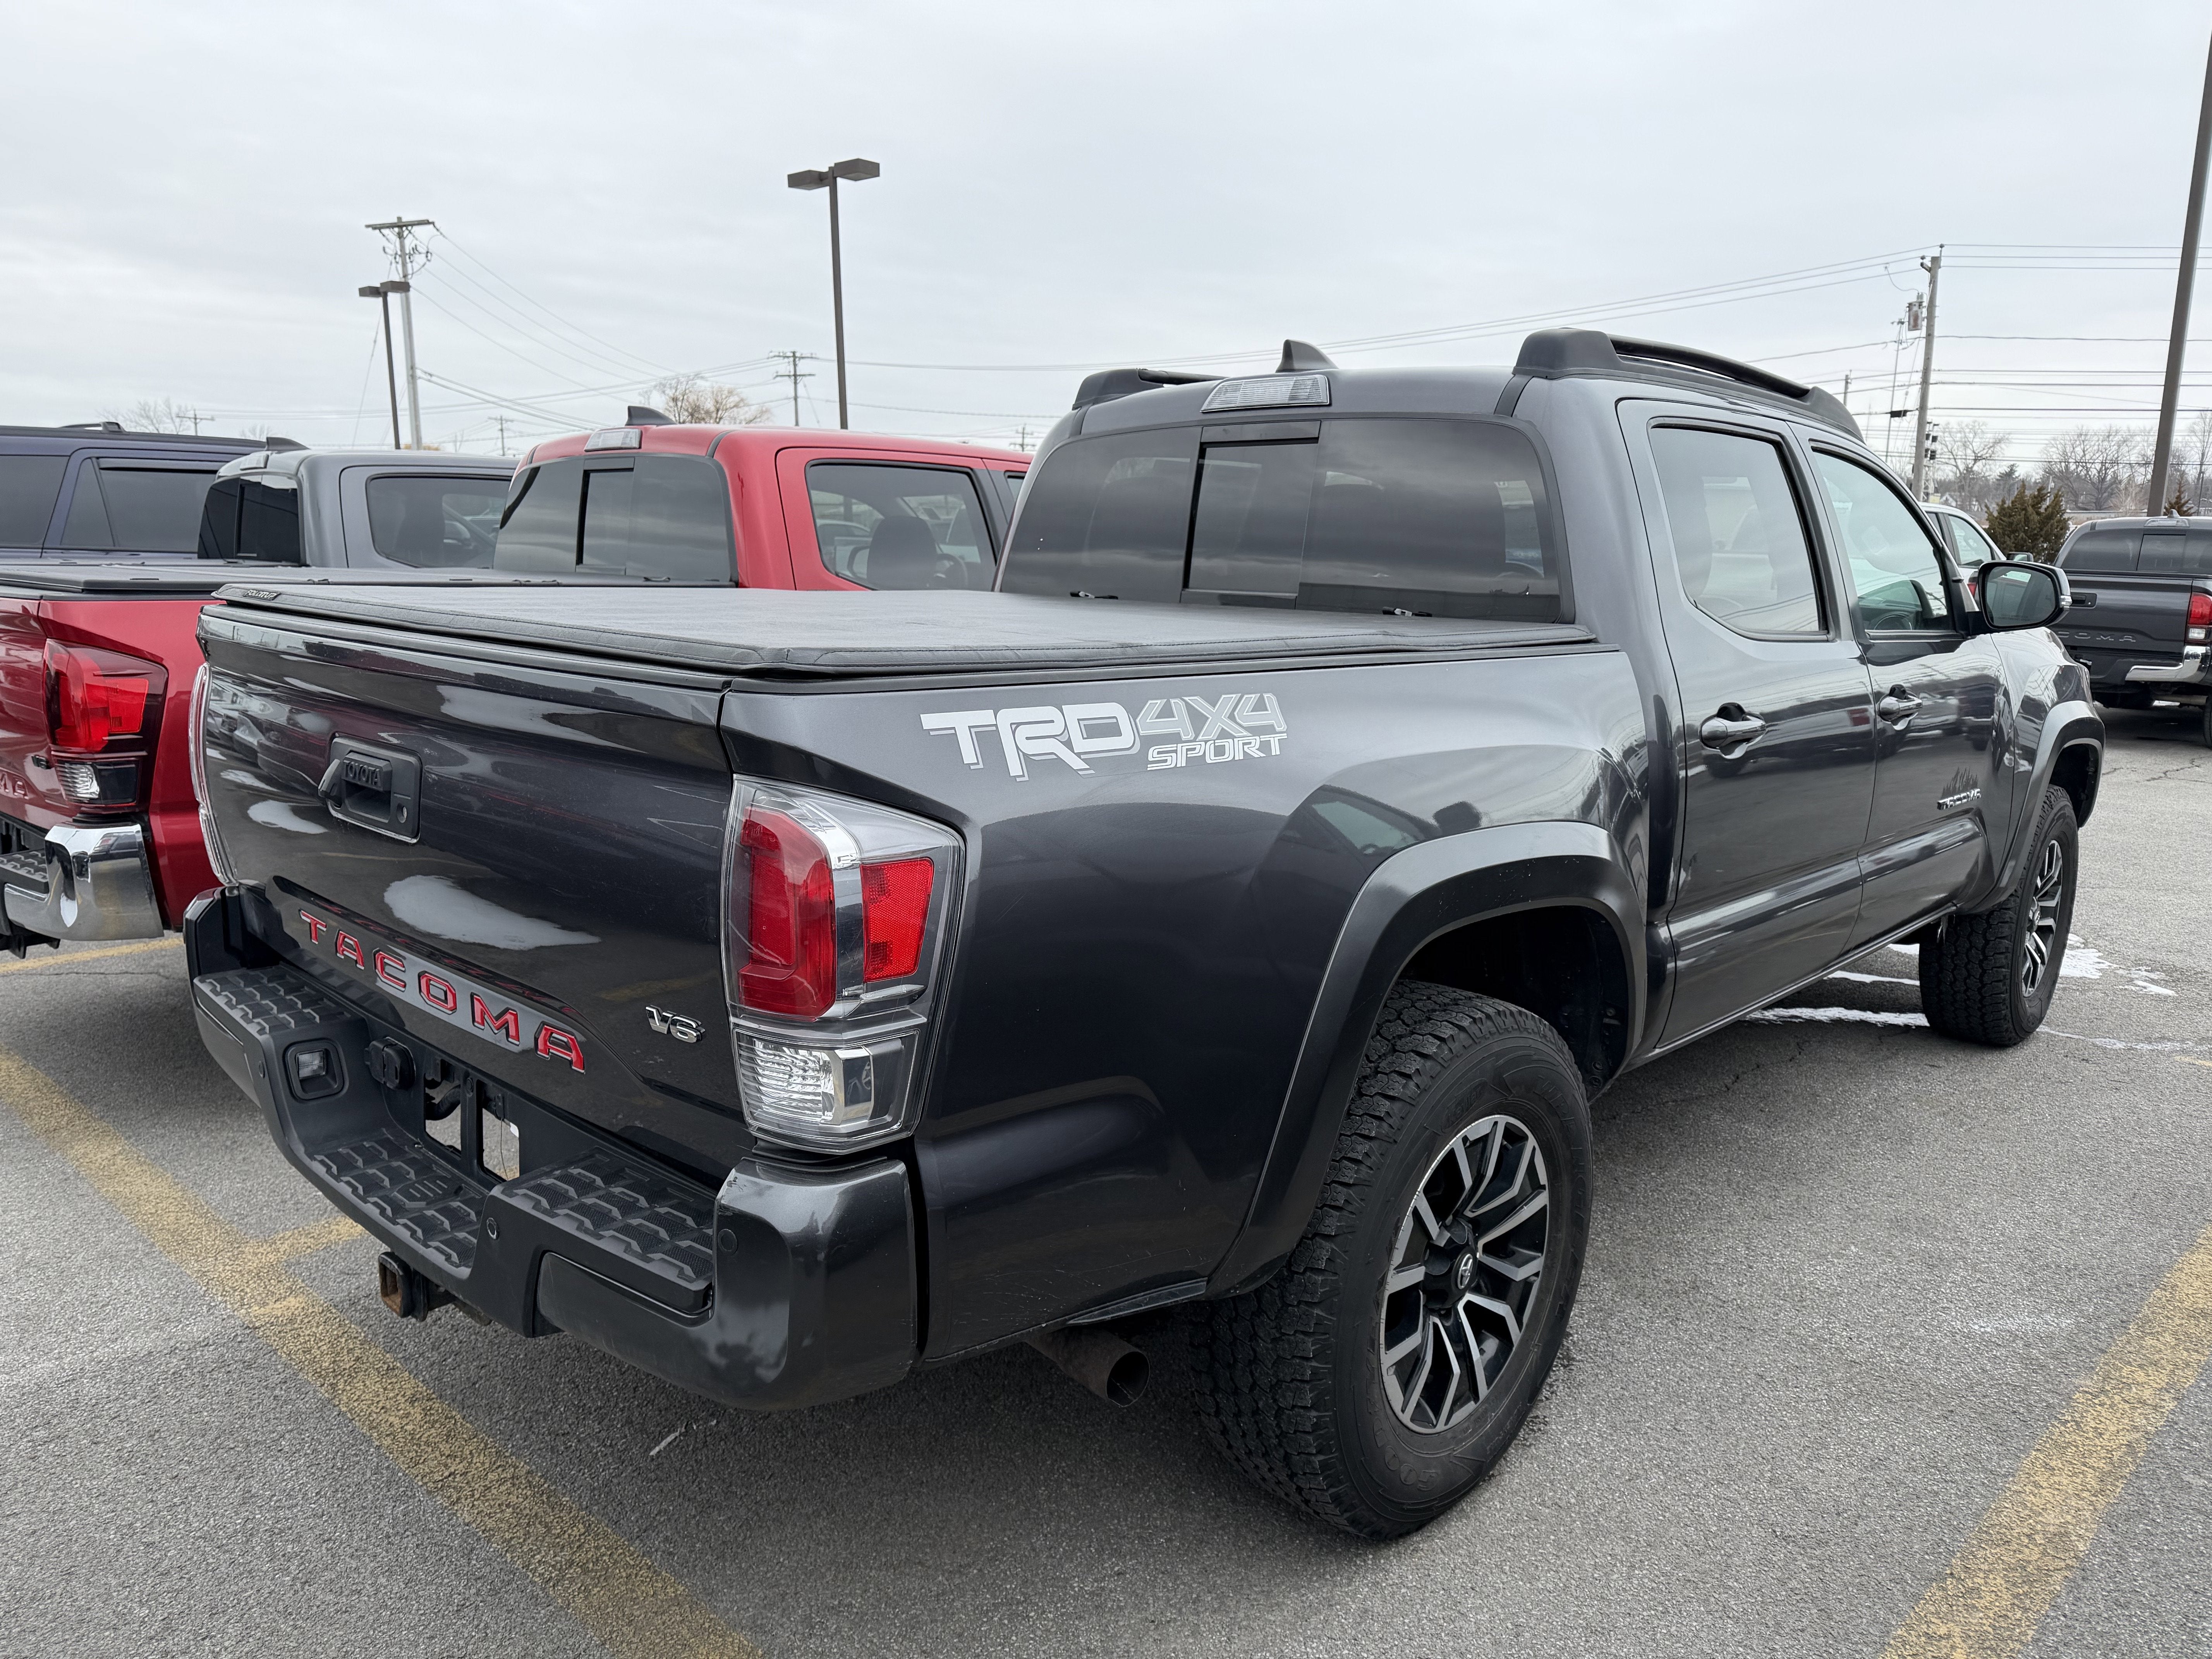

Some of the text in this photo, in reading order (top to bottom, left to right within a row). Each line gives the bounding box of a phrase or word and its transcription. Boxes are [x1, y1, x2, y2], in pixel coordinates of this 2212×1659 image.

[920, 702, 1140, 781] TRD
[1147, 733, 1288, 771] SPORT
[343, 759, 381, 787] TOYOTA
[298, 907, 586, 1074] TACOMA
[645, 1005, 708, 1044] V6
